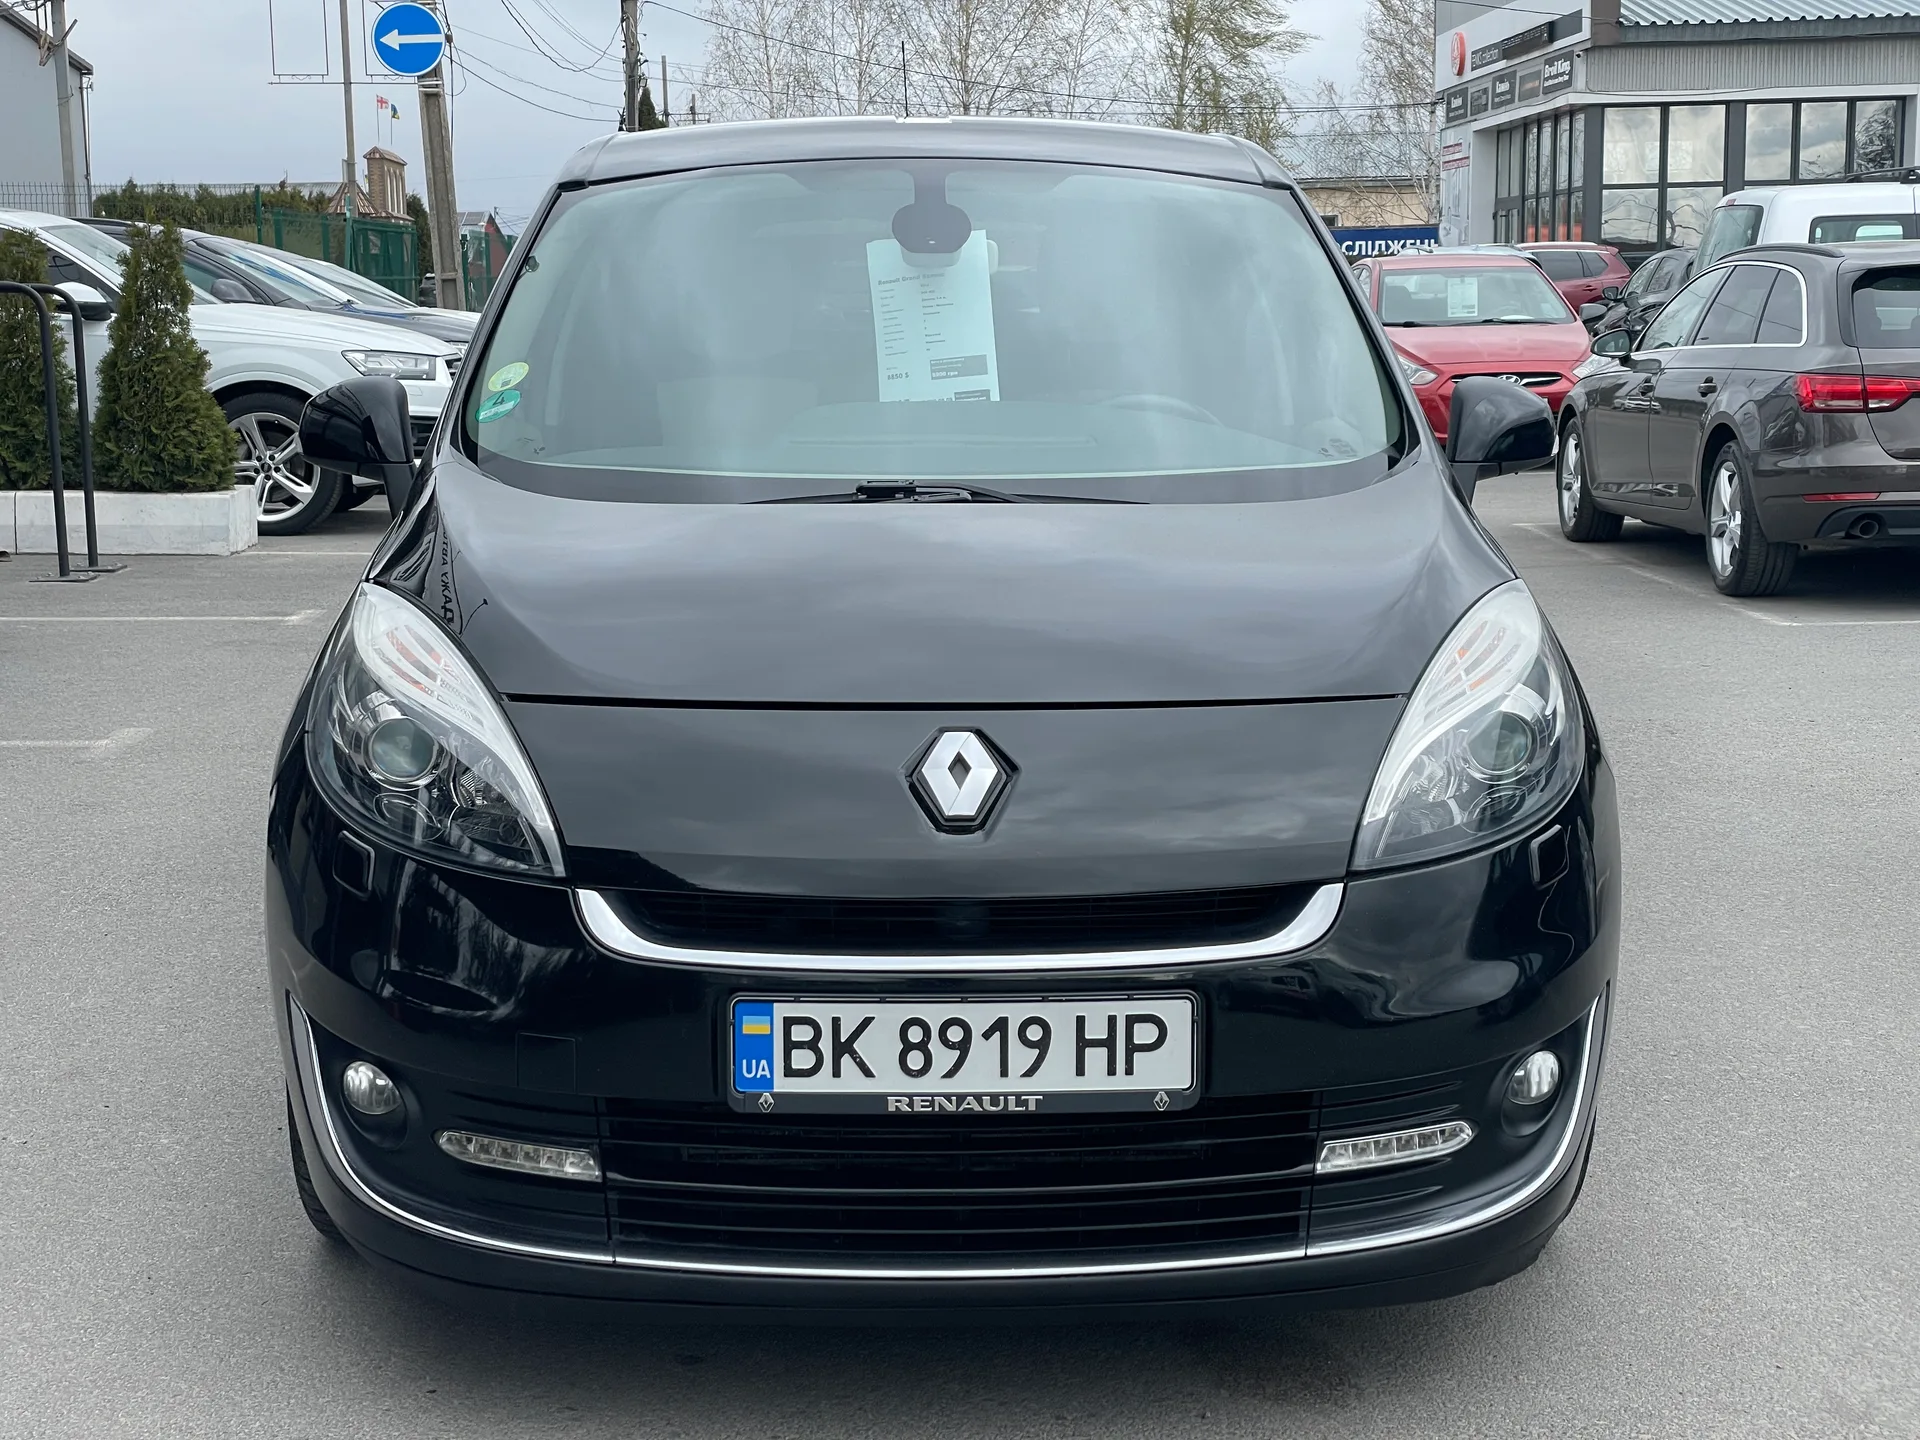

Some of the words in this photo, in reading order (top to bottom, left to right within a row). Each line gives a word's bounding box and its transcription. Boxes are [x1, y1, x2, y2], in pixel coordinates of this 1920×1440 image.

[742, 1060, 771, 1079] UA
[782, 1015, 876, 1079] BK
[898, 1015, 1052, 1079] 8919
[1075, 1013, 1169, 1077] HP
[887, 1095, 1044, 1113] RENAULT
